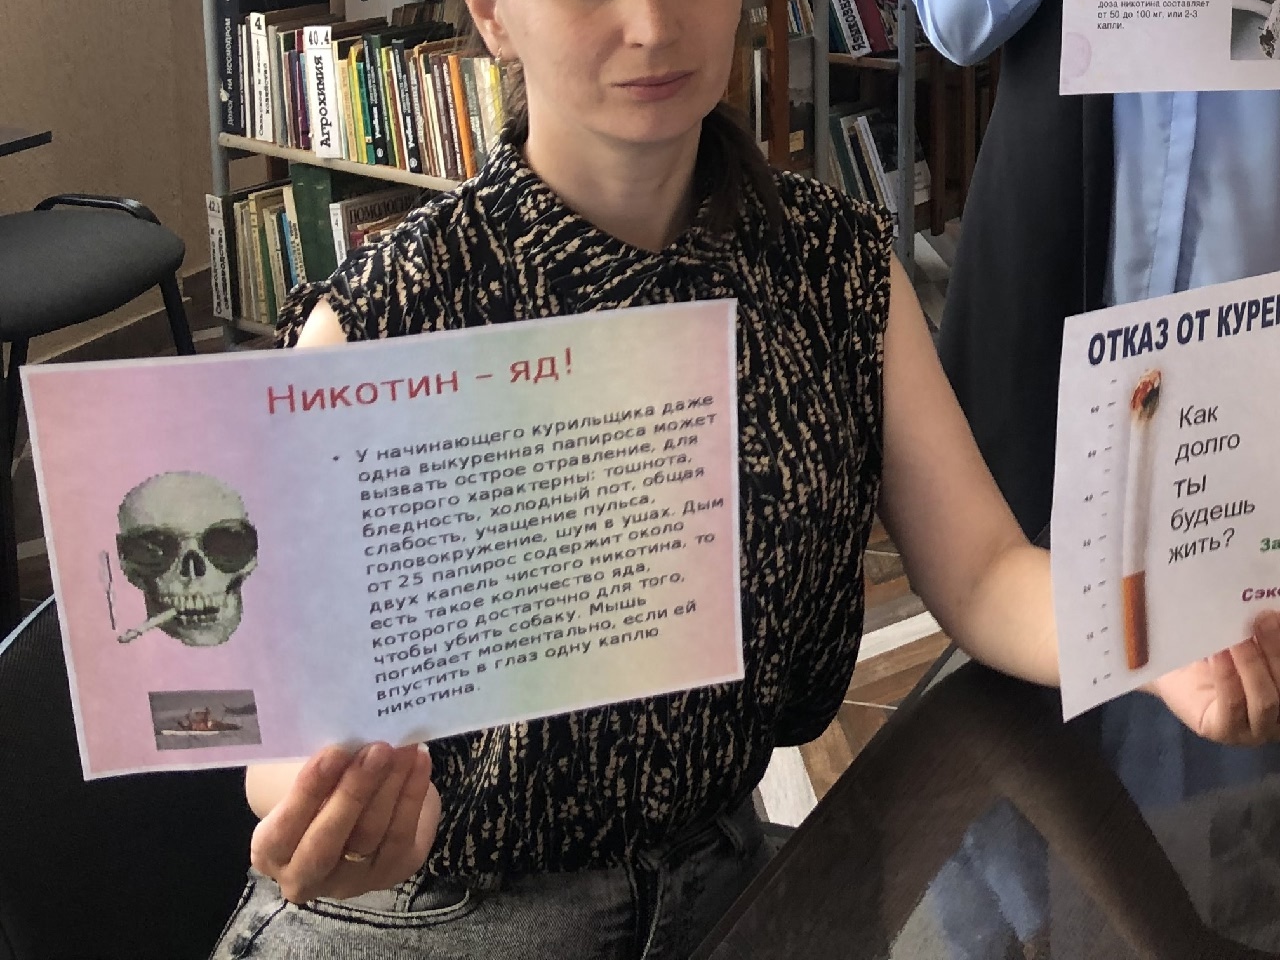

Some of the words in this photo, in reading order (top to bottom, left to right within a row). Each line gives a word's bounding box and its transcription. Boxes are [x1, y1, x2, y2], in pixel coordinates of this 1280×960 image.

[254, 16, 263, 30] 4
[308, 29, 330, 46] 40.4
[313, 54, 332, 148] Агрохимия
[1088, 318, 1168, 366] ОТКАЗ
[1177, 309, 1210, 345] ОТ
[268, 367, 459, 415] Никотин
[510, 346, 574, 389] яд!
[356, 449, 368, 462] У
[377, 429, 524, 460] начинающего
[532, 406, 654, 437] курильщика
[662, 396, 714, 416] даже
[1179, 405, 1219, 427] Как
[359, 466, 410, 483] одна
[420, 444, 543, 474] выкуренная
[553, 427, 646, 451] папироса
[654, 413, 717, 434] может
[361, 480, 447, 500] вызвать
[455, 466, 526, 486] острое
[533, 443, 655, 472] отравление,
[663, 435, 698, 451] для
[1175, 432, 1241, 465] долго
[362, 496, 460, 525] которого
[468, 471, 594, 502] характерны:
[604, 454, 691, 477] тошнота,
[363, 512, 481, 537] бледность,
[491, 486, 589, 517] холодный
[597, 481, 635, 497] пот,
[643, 467, 704, 486] общая
[1170, 498, 1256, 532] будешь
[1174, 475, 1207, 498] ты
[364, 533, 466, 556] слабость,
[476, 510, 577, 540] учащение
[584, 495, 655, 516] пульса,
[367, 534, 547, 575] головокружение,
[556, 522, 596, 538] шум
[605, 519, 613, 528] в
[622, 508, 674, 528] ушах.
[683, 498, 723, 516] Дым
[1168, 528, 1236, 564] жить?
